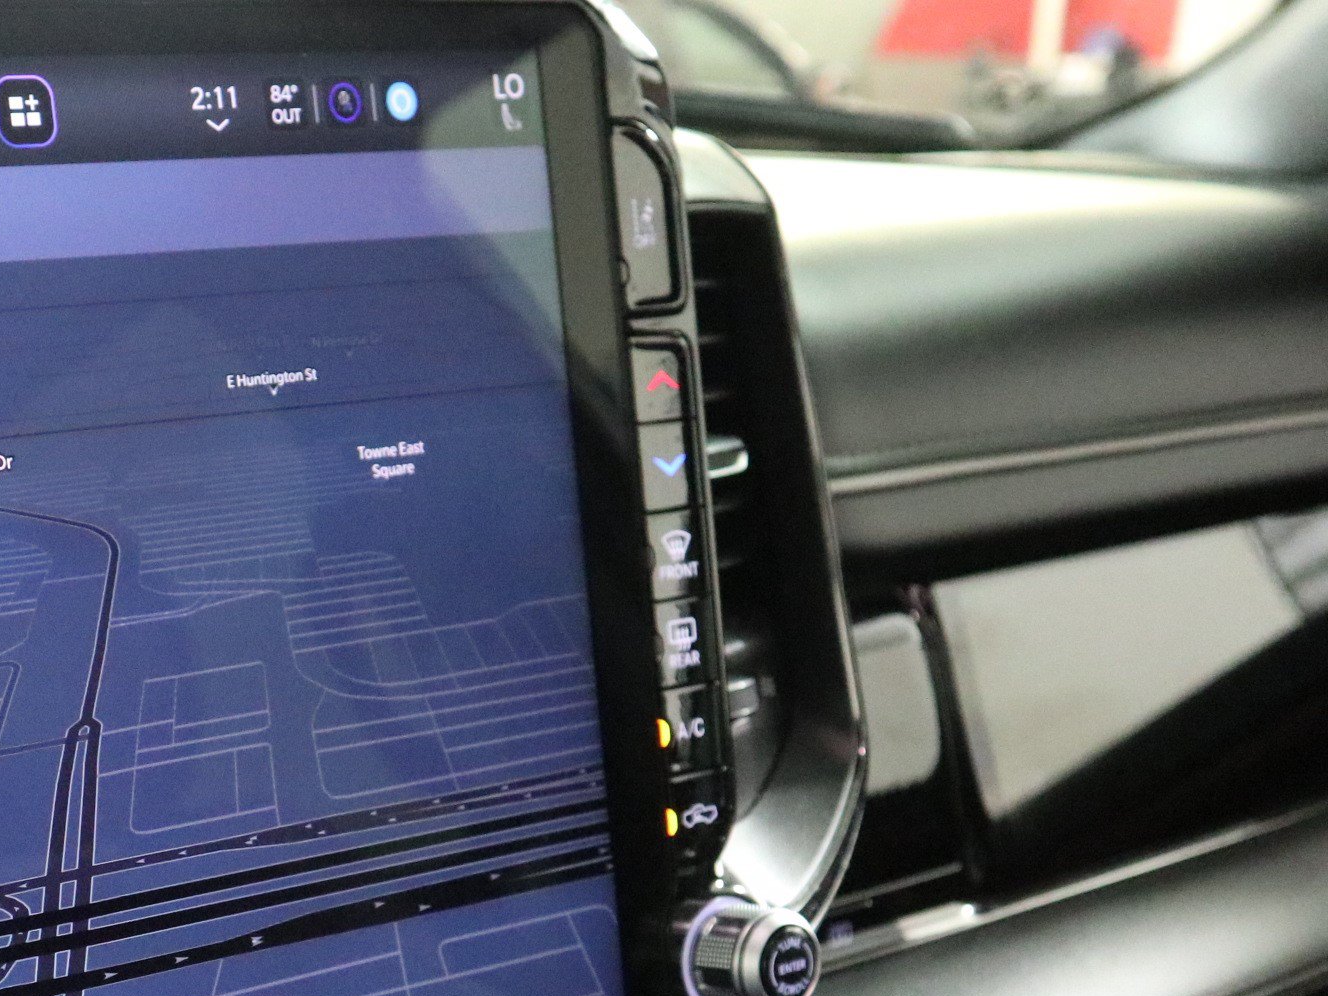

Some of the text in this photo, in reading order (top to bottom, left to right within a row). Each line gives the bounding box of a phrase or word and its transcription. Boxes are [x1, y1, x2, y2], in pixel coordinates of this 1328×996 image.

[269, 84, 299, 104] 84°
[492, 73, 525, 100] LO
[189, 85, 238, 111] 2:11
[271, 106, 302, 125] OUT
[226, 367, 318, 389] E Huntington St
[357, 440, 425, 461] Towne East
[371, 461, 415, 480] Square
[658, 561, 699, 580] FRONT
[668, 650, 701, 668] REAR
[676, 716, 706, 740] A/C
